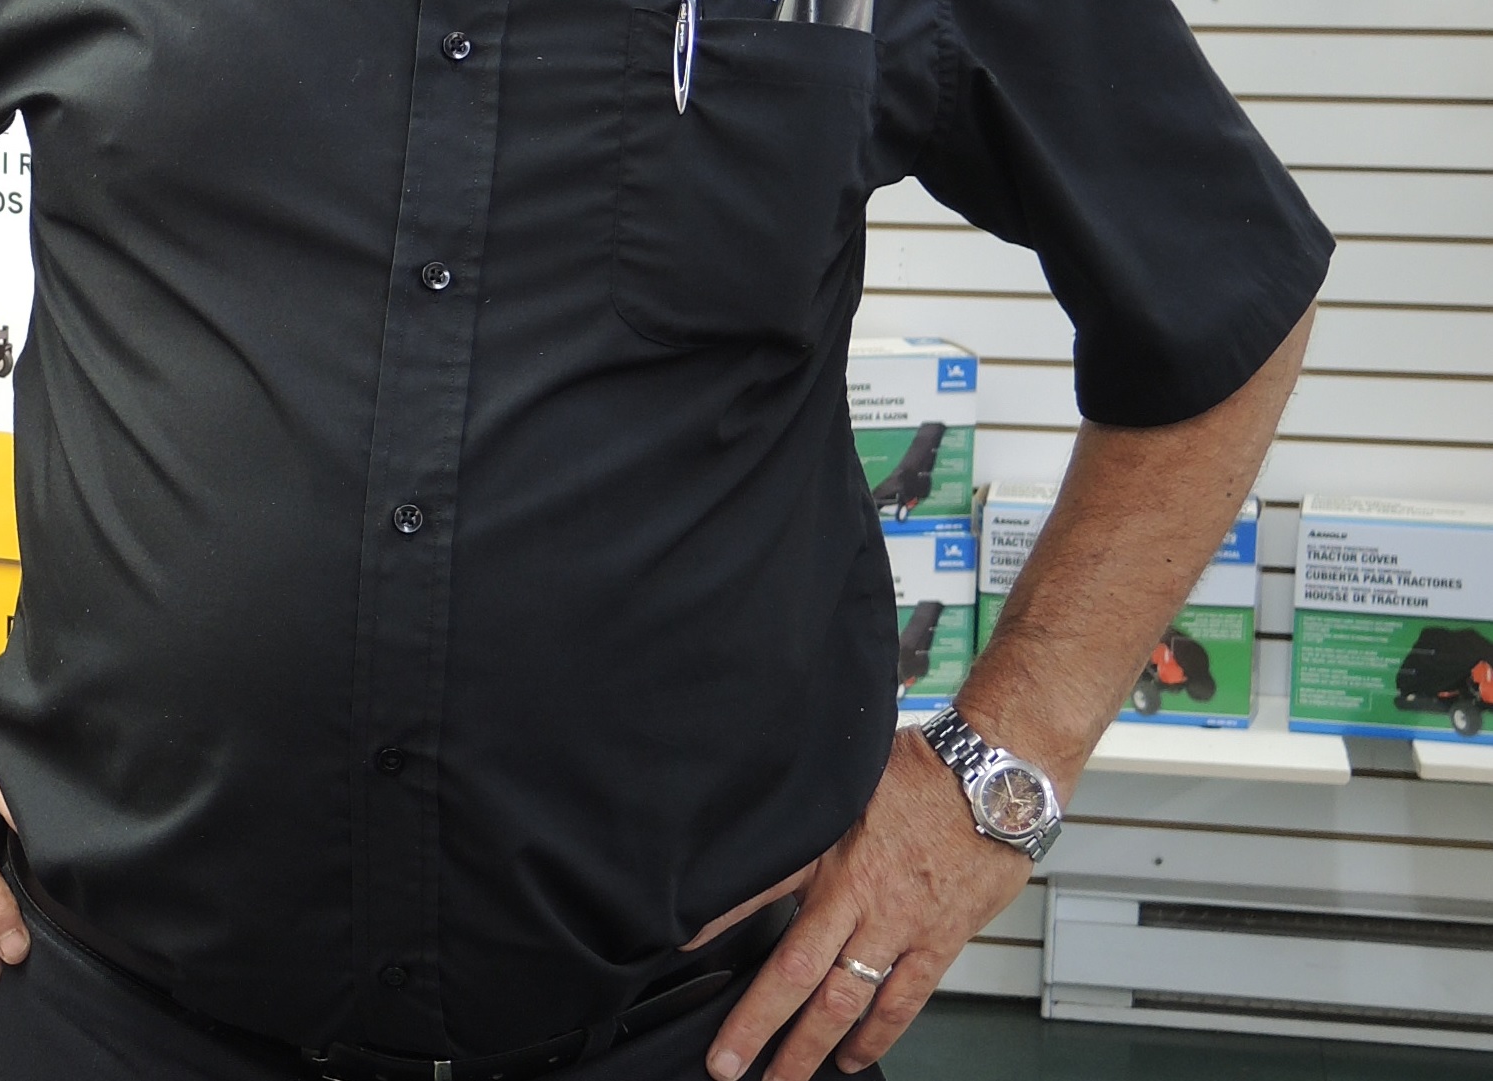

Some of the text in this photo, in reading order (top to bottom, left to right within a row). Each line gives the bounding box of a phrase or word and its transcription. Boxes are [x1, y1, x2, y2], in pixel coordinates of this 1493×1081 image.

[1307, 549, 1398, 565] TRACTOR COVER
[1305, 570, 1359, 583] CUBIERTA
[1363, 573, 1393, 586] PARA
[1397, 575, 1463, 589] TRACTORES
[1305, 589, 1349, 602] HOUSSE
[1353, 592, 1367, 603] DE
[1371, 593, 1429, 608] TRACTEUR
